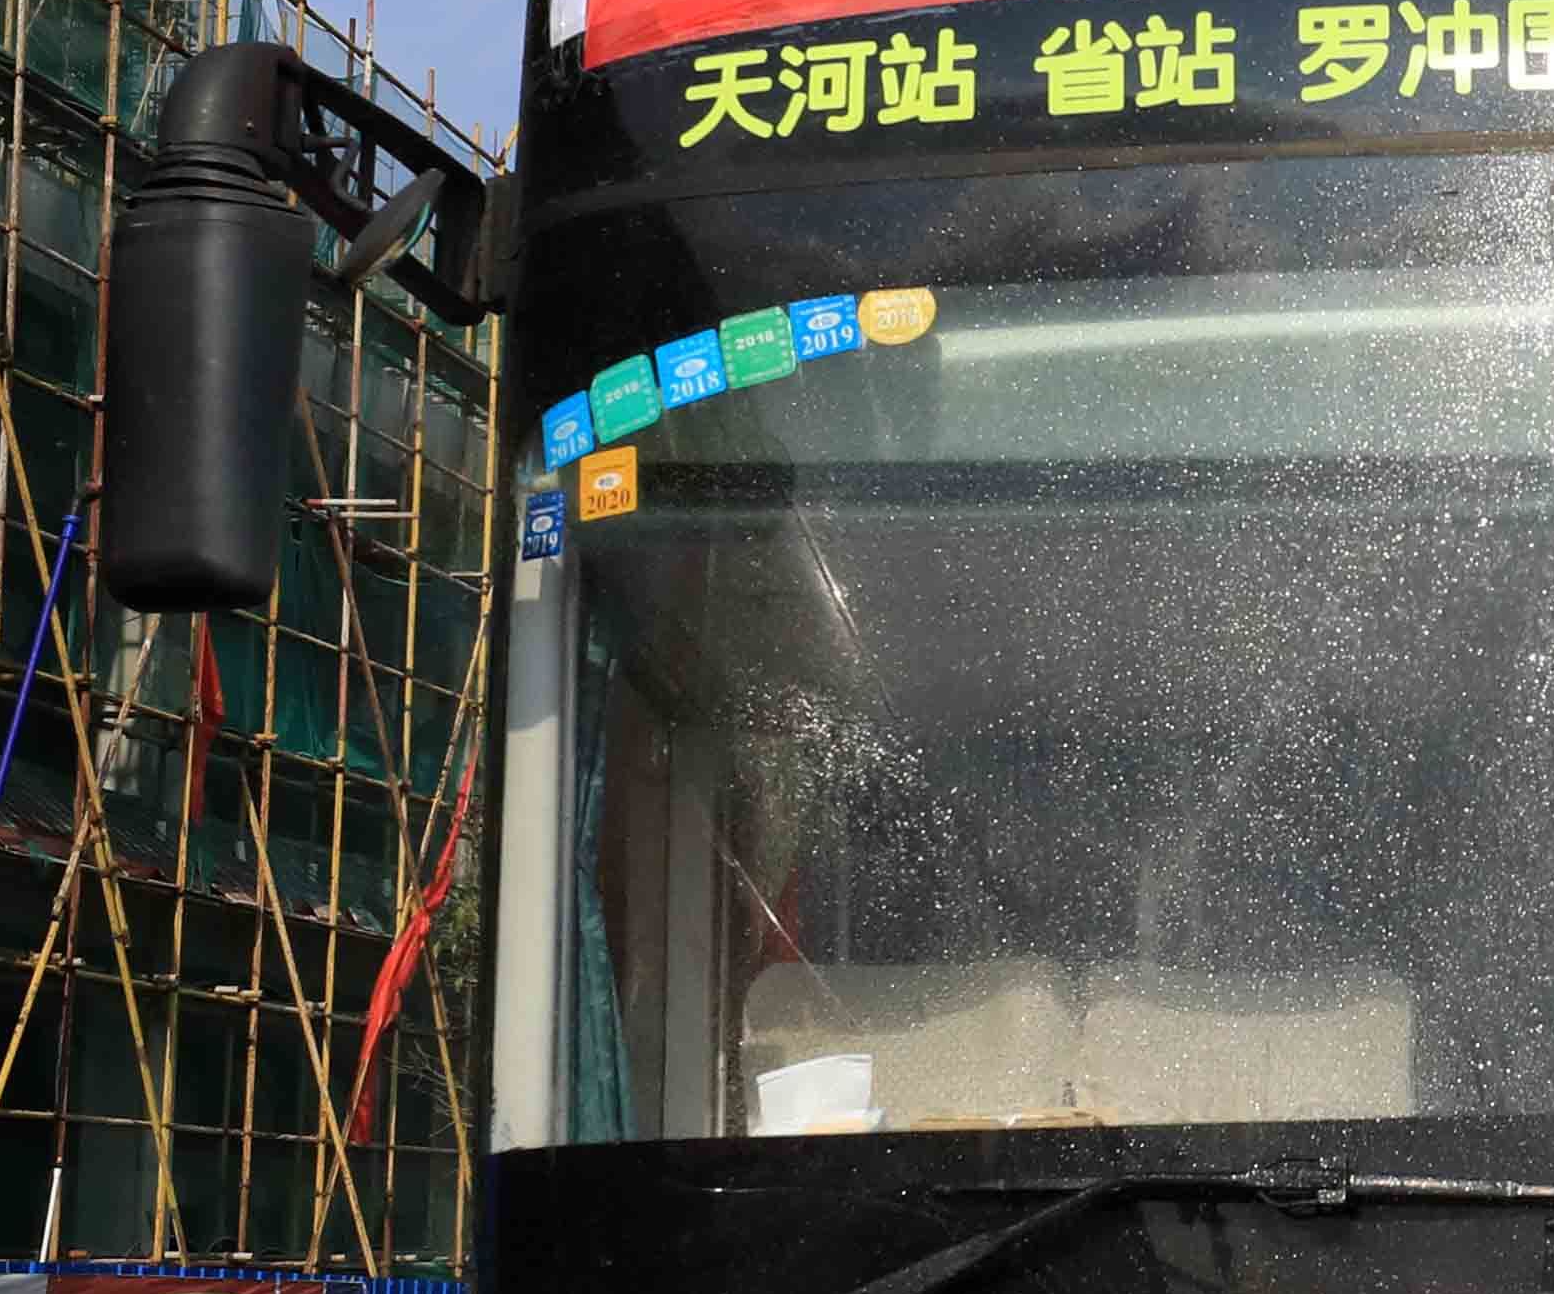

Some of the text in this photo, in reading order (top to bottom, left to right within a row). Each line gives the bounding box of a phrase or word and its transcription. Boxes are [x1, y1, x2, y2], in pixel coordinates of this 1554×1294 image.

[679, 28, 978, 148] 天河站
[1033, 11, 1237, 117] 省站
[801, 325, 855, 356] 2019
[669, 371, 721, 403] 2018
[588, 489, 631, 514] 2020
